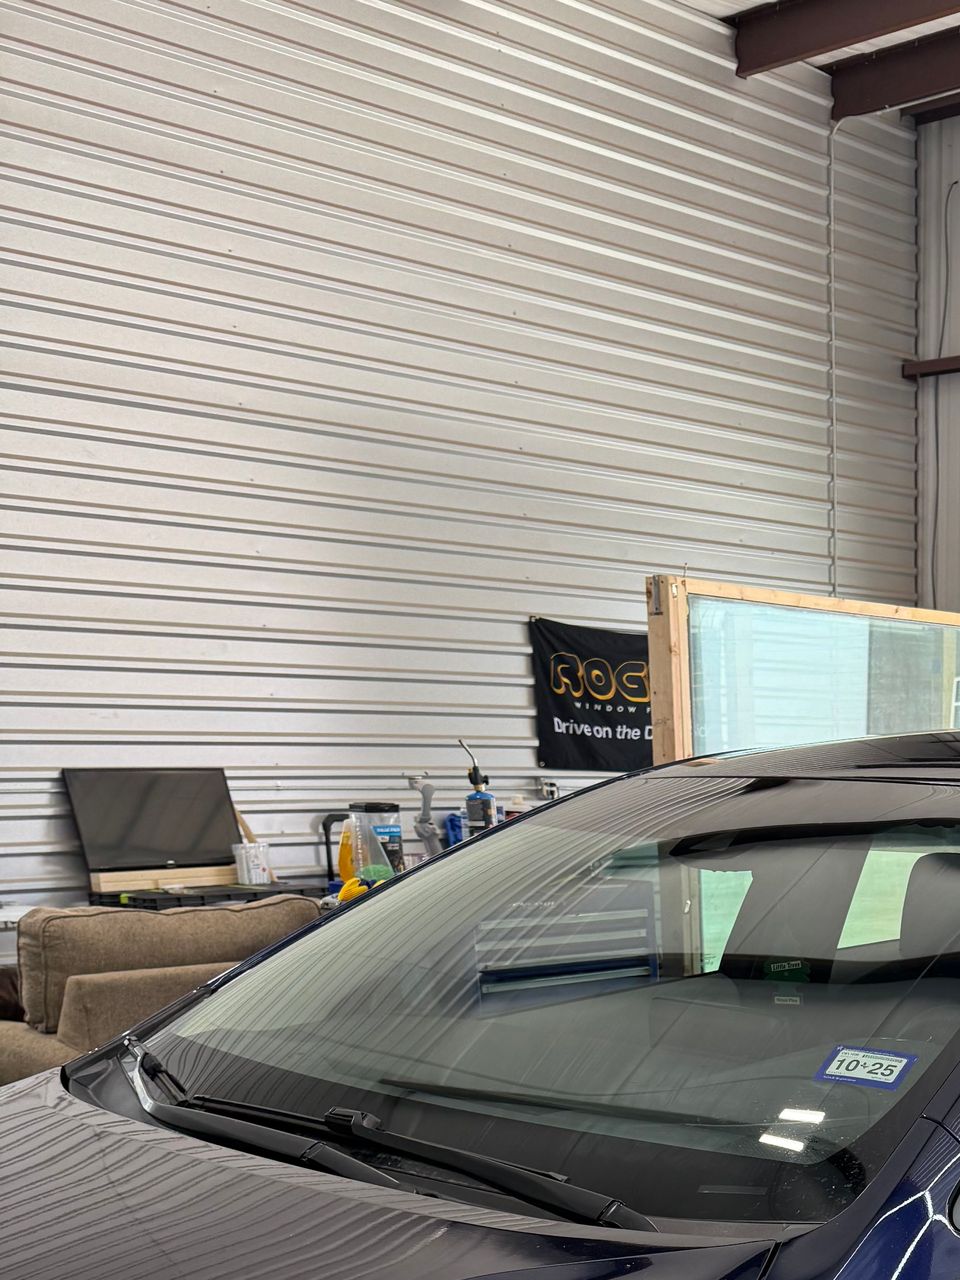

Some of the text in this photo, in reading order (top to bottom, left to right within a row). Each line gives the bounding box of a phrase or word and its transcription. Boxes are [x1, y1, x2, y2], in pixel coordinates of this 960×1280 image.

[550, 652, 650, 703] ROG
[574, 701, 637, 713] WINDOW
[553, 717, 592, 736] Drive
[594, 727, 612, 739] on
[616, 725, 641, 740] the
